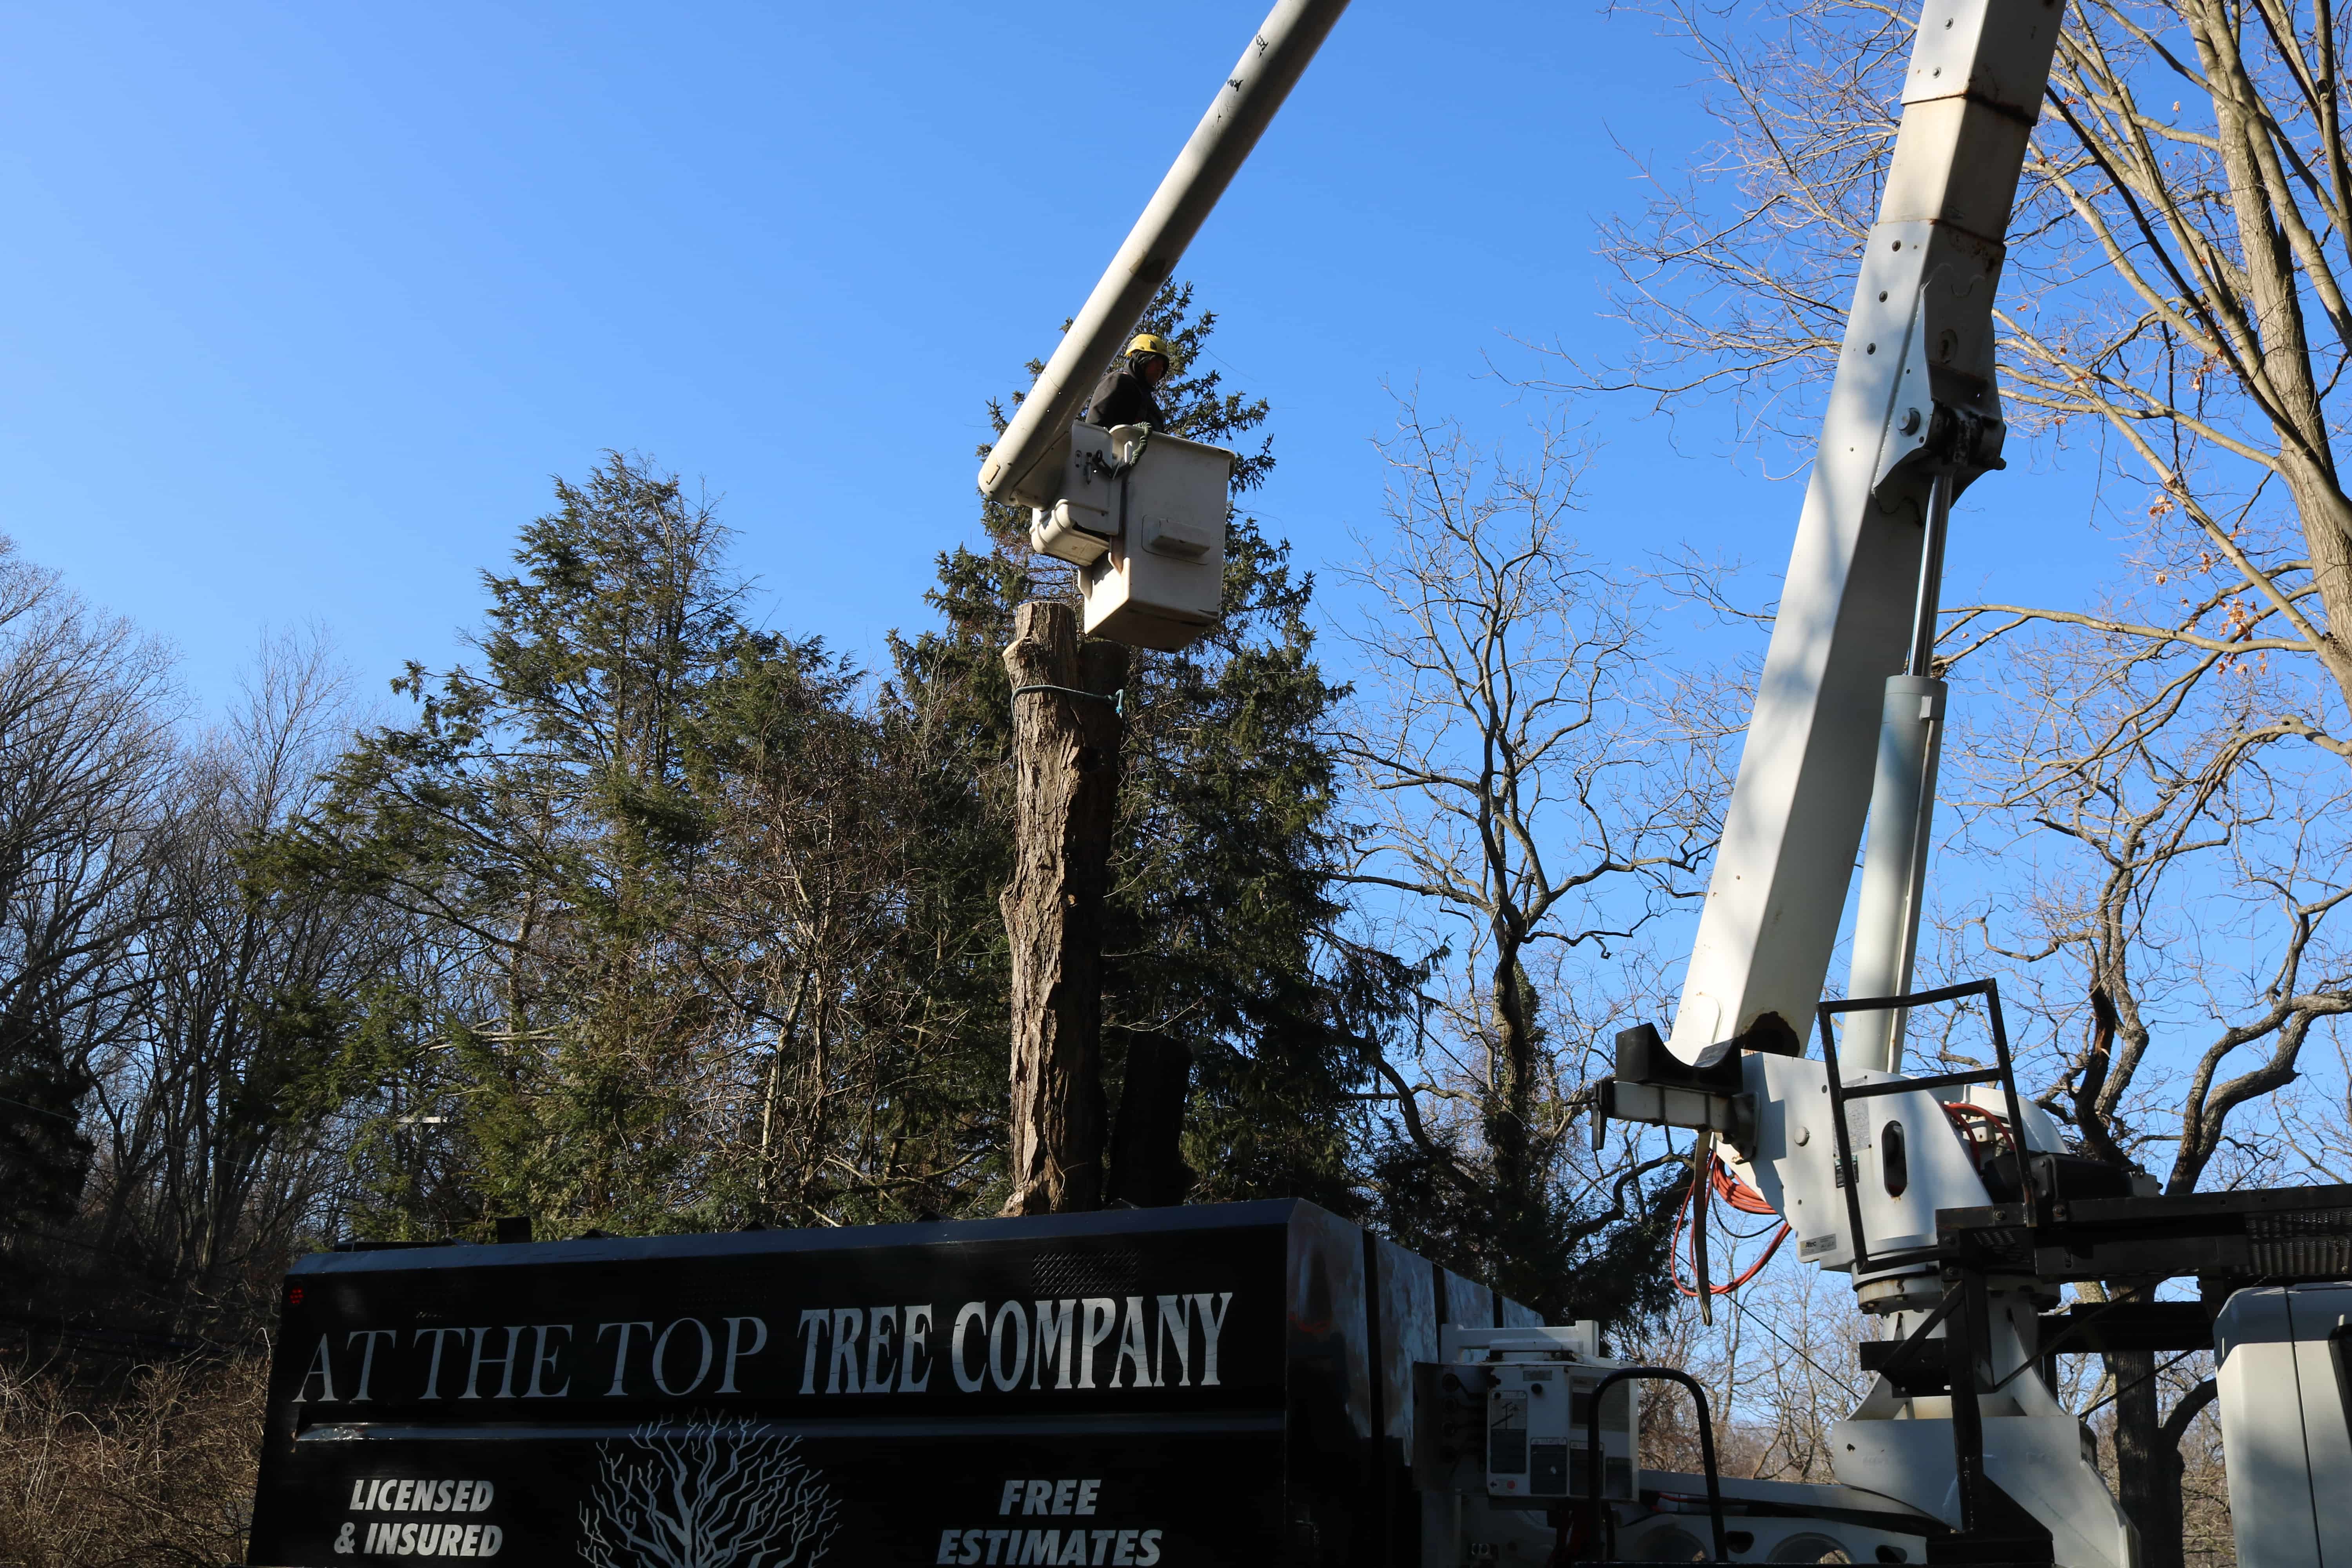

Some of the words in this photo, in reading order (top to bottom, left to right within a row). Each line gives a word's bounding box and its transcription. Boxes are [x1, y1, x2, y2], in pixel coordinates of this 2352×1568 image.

[292, 1330, 396, 1403] AT
[414, 1324, 572, 1399] THE
[596, 1317, 768, 1396] TOP
[797, 1303, 933, 1394] TREE
[952, 1292, 1233, 1392] COMPANY
[349, 1479, 494, 1512] LICENSED
[999, 1479, 1102, 1515] FREE
[334, 1522, 355, 1553] &
[364, 1523, 502, 1557] INSURED
[936, 1529, 1163, 1567] ESTIMATES
